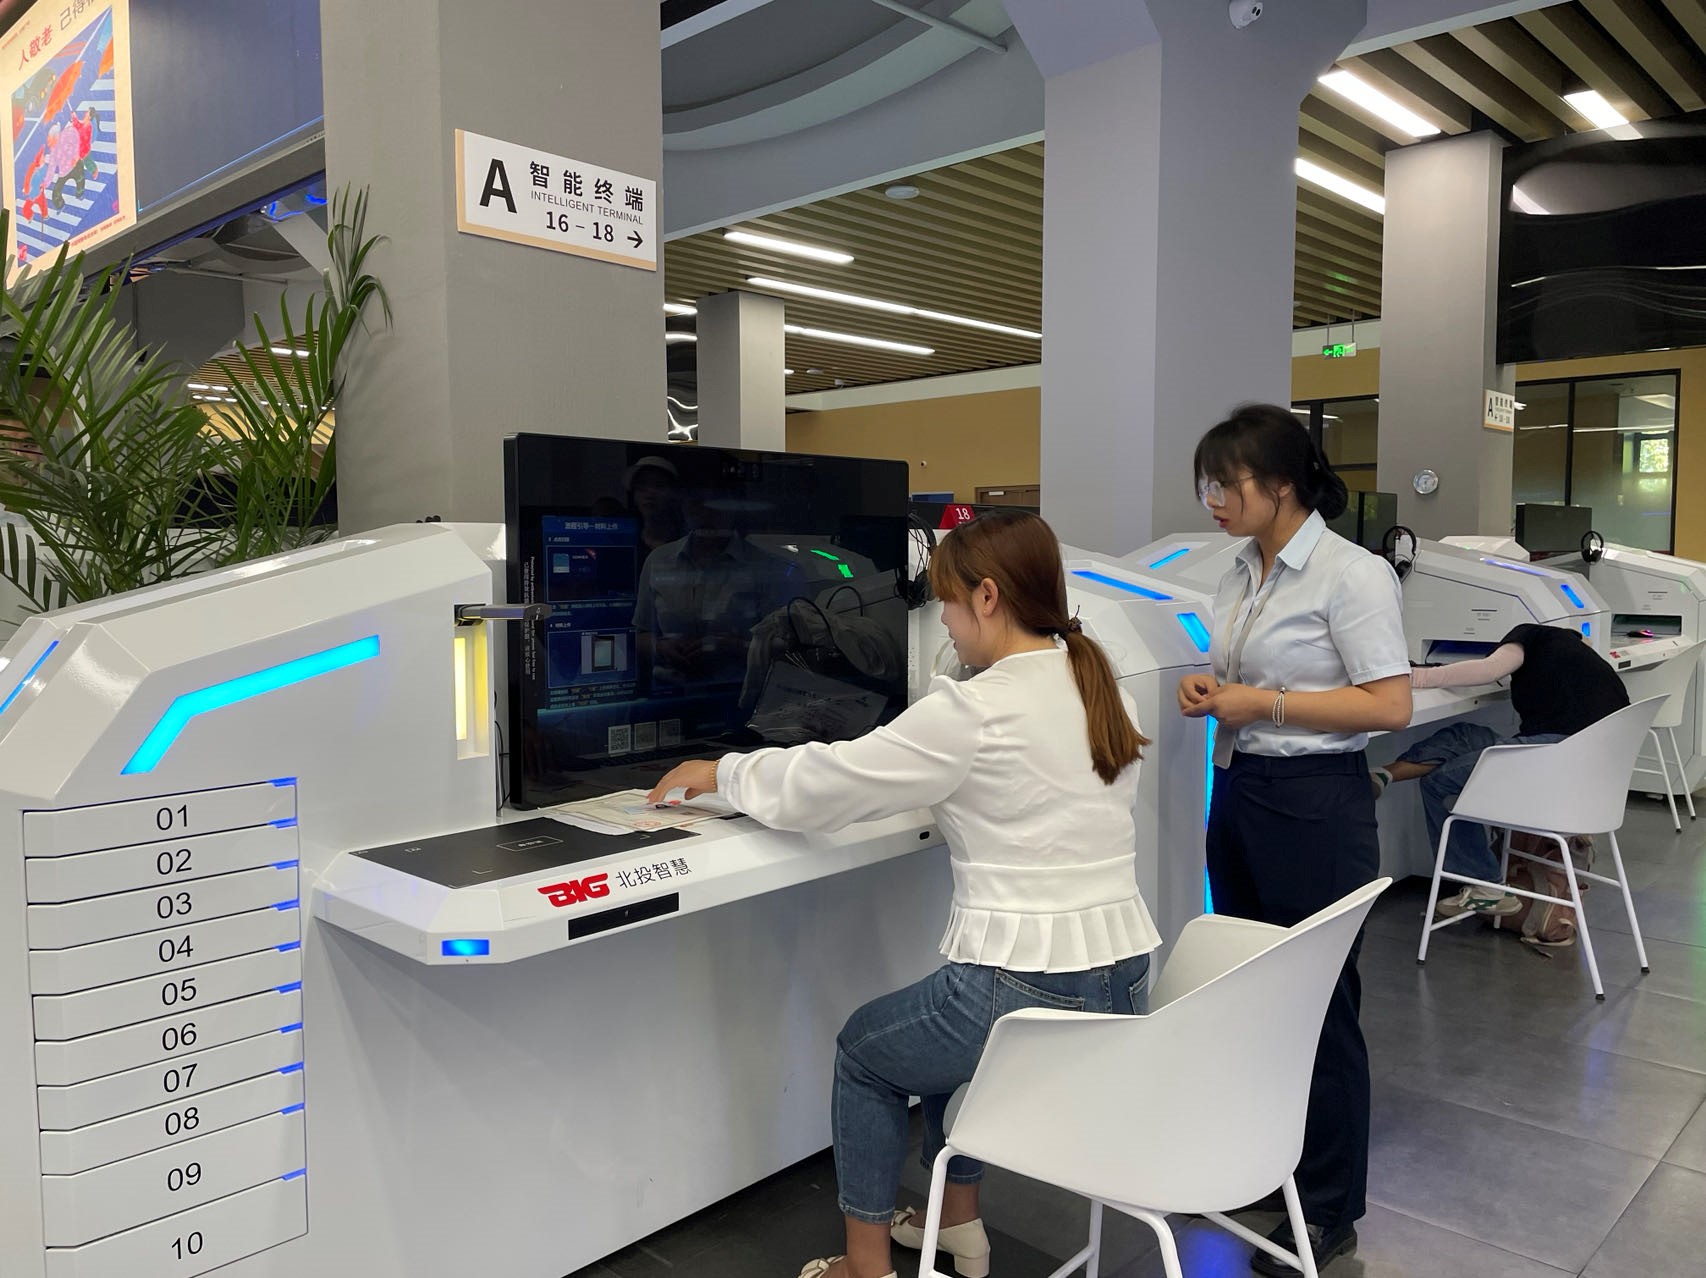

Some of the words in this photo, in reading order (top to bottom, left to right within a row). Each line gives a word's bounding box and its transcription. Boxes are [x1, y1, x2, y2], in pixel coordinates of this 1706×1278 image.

[19, 25, 52, 70] 人敬老
[60, 0, 95, 31] 己得
[479, 158, 517, 214] A
[529, 161, 644, 212] 智能终端
[531, 190, 595, 214] INTELLIGENT
[597, 206, 644, 225] TERMINAL
[1487, 398, 1493, 417] A
[956, 508, 970, 520] 18
[157, 805, 189, 831] 01
[157, 849, 192, 876] 02
[537, 872, 611, 908] BIG
[615, 857, 692, 889] 北投智慧
[157, 892, 192, 919] 03
[159, 935, 194, 962] 04
[162, 978, 197, 1006] 05
[163, 1023, 197, 1051] 06
[164, 1064, 198, 1093] 07
[166, 1107, 200, 1135] 08
[168, 1163, 202, 1191] 09
[172, 1232, 203, 1259] 10
